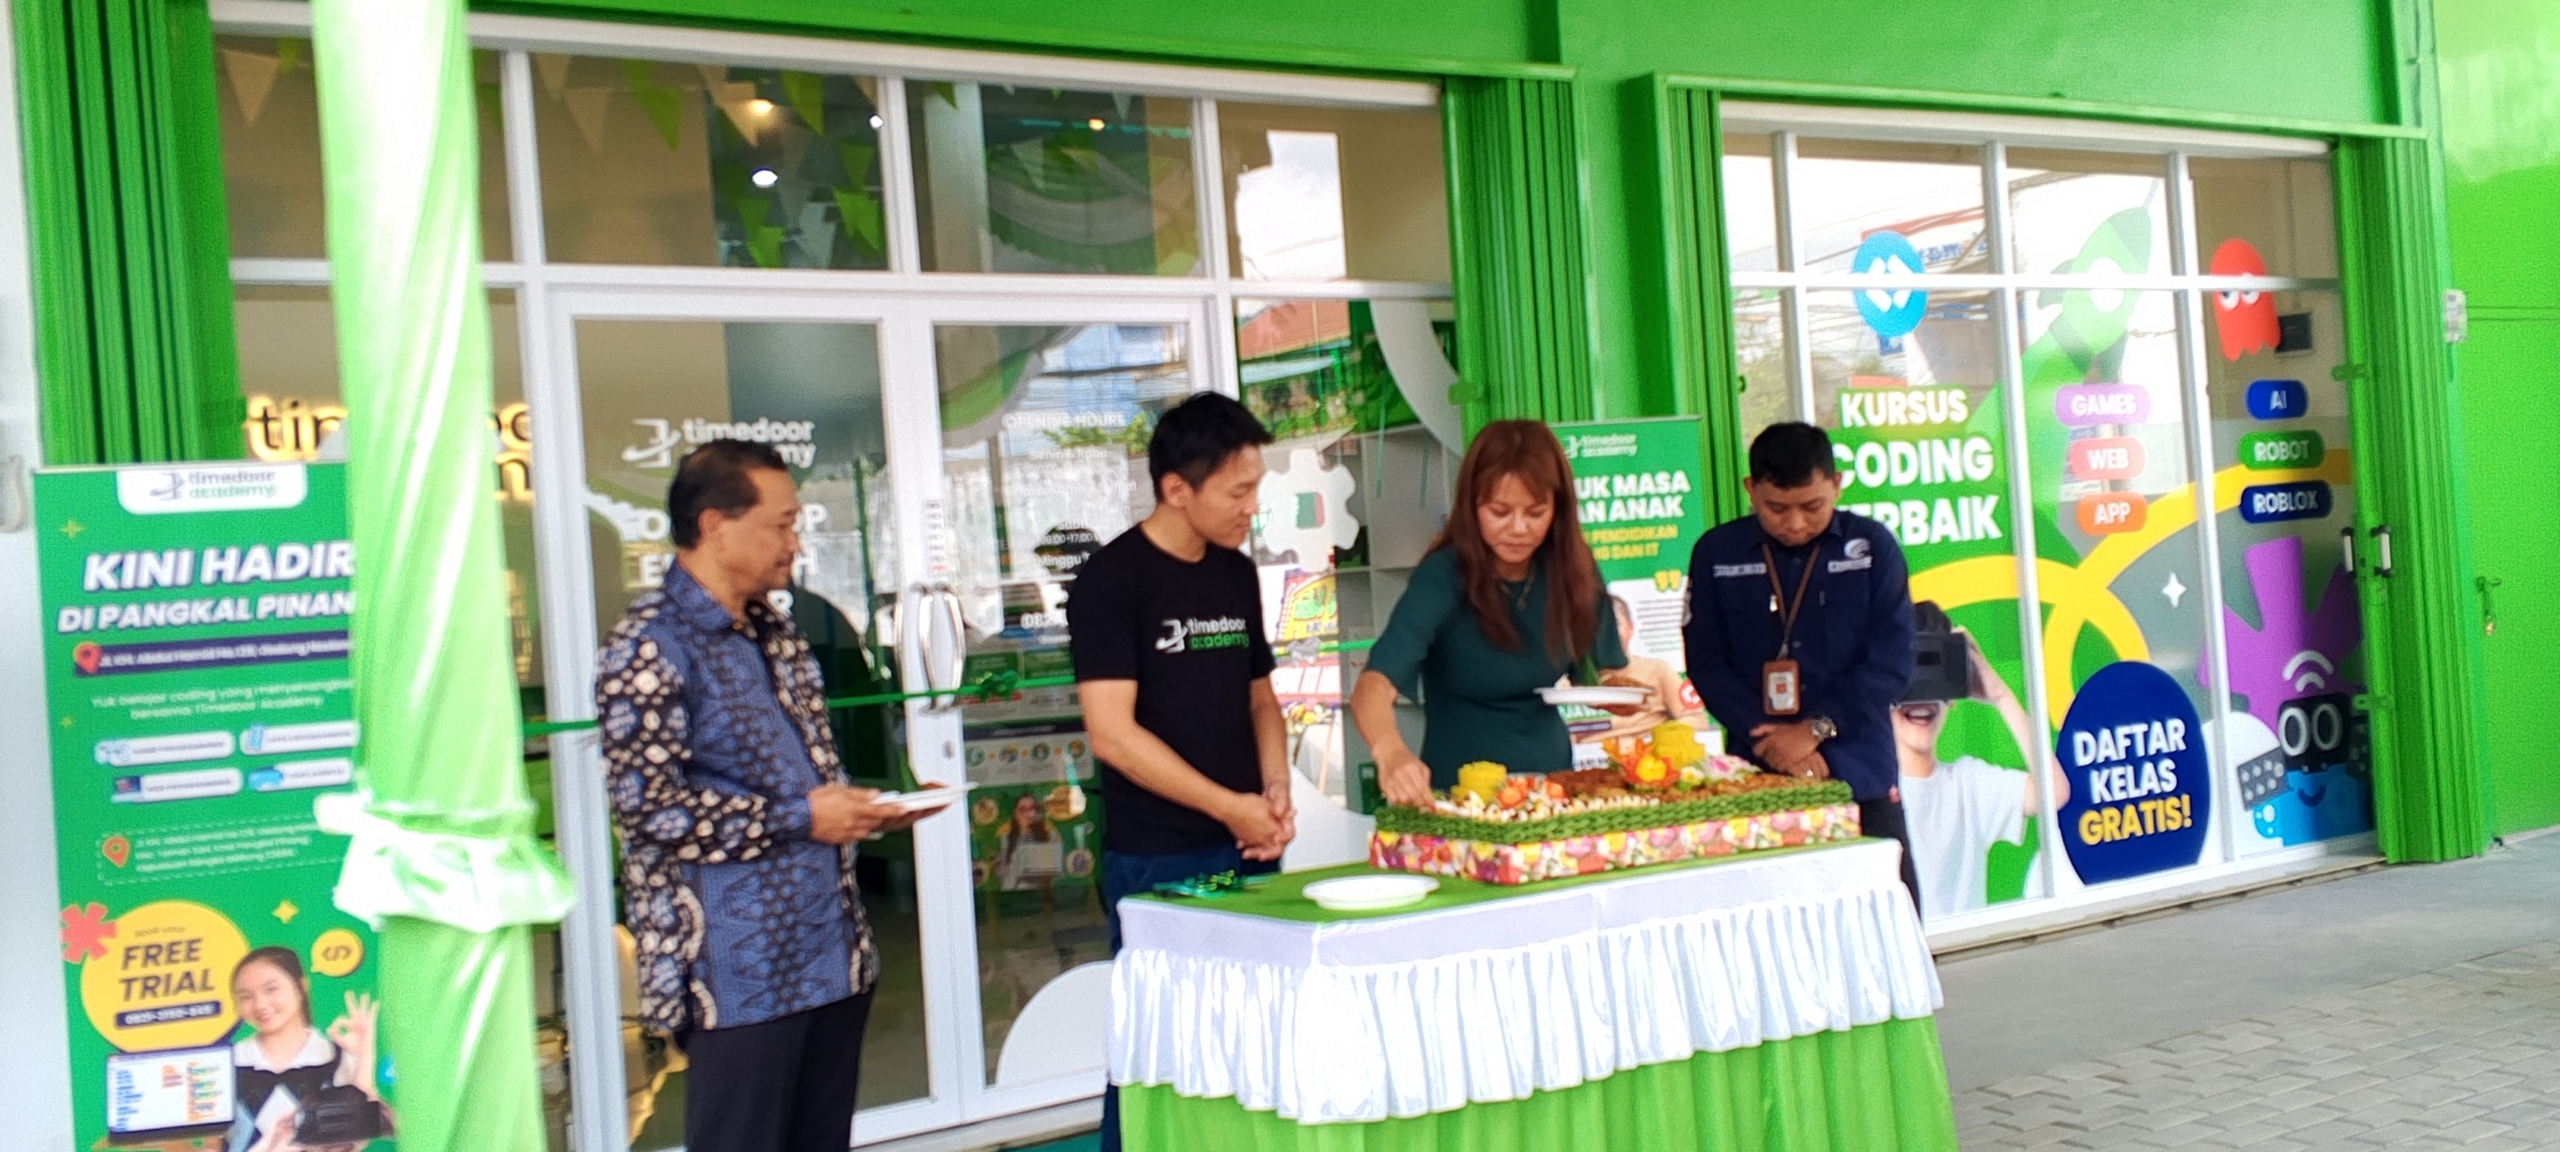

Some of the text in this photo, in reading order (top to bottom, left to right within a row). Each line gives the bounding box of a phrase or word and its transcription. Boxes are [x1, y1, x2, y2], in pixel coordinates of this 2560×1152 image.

[1841, 389, 1969, 429] KURSUS
[2071, 392, 2137, 417] GAMES
[2269, 390, 2288, 411] AI
[681, 417, 815, 442] timedoor
[1832, 436, 1995, 490] CODING
[2086, 447, 2130, 470] WEB
[2254, 440, 2311, 462] ROBOT
[188, 470, 277, 485] timedoor
[1612, 470, 1691, 497] MASA
[1609, 494, 1685, 521] ANAK
[2094, 501, 2131, 525] APP
[2253, 489, 2320, 514] ROBLOX
[84, 540, 354, 592] KINI HADIR
[58, 591, 354, 633] DI PANGKAL PINAN
[1187, 616, 1246, 634] timedoor
[1190, 632, 1250, 651] academy
[2073, 717, 2186, 768] DAFTAR
[2090, 757, 2178, 805] KELAS
[2078, 793, 2193, 847] GRATIS!
[121, 937, 204, 971] FREE
[118, 968, 216, 1002] TRIAL
